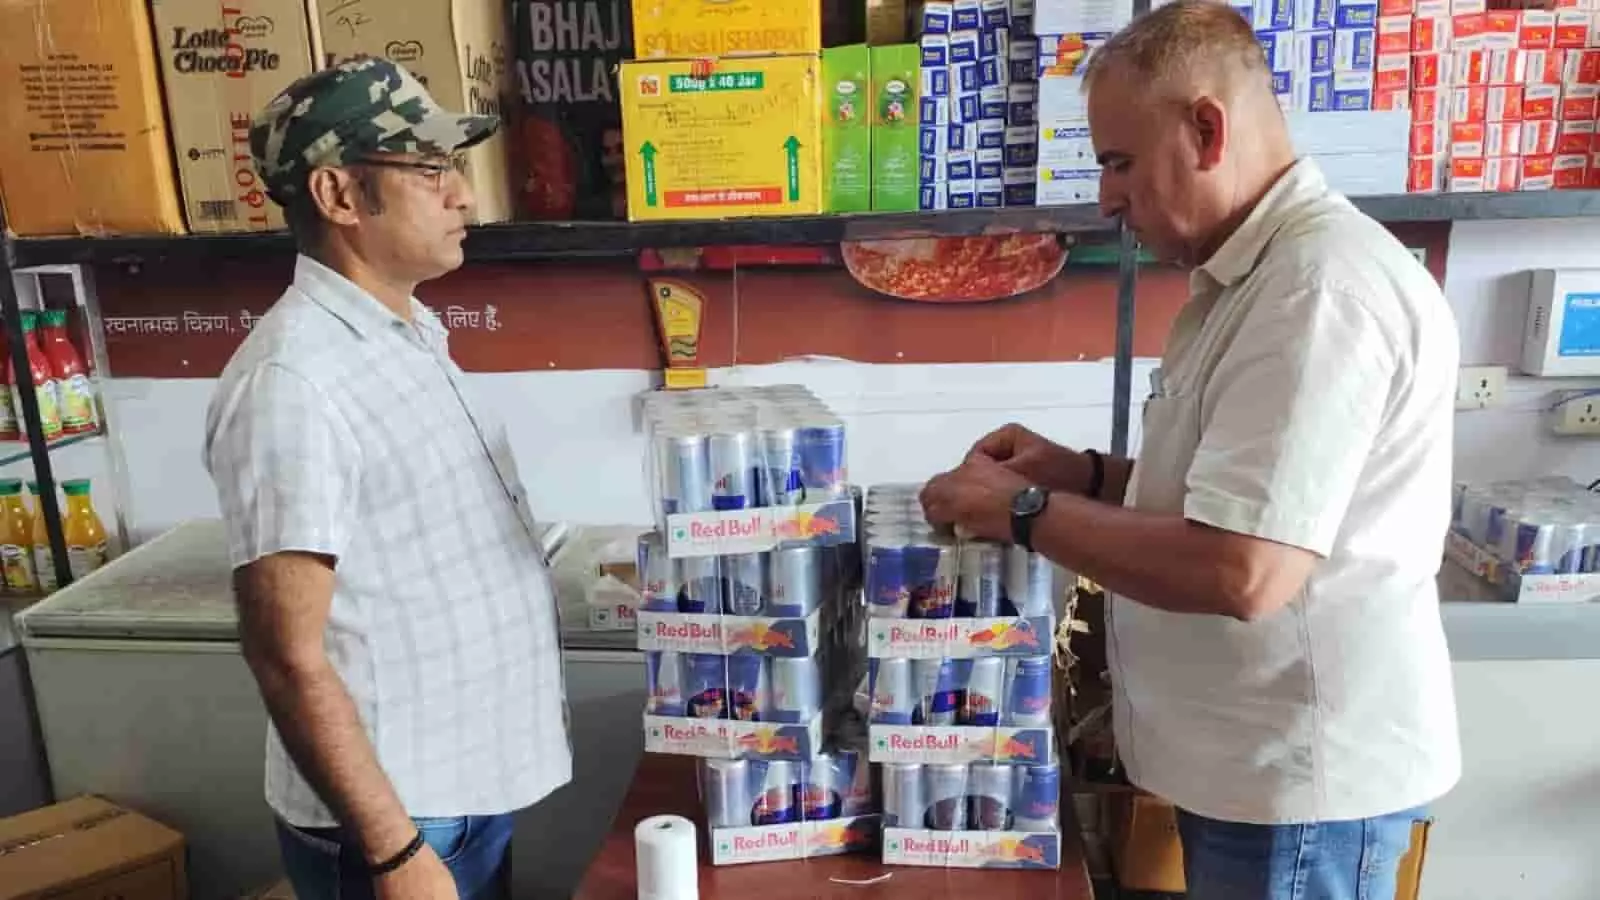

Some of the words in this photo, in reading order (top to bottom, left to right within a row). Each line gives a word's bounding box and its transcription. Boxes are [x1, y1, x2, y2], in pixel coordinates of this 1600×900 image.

[173, 27, 230, 48] Lotte
[173, 51, 241, 74] Choco
[245, 48, 280, 71] Pie
[737, 74, 757, 87] Jar
[446, 304, 480, 328] लिए
[104, 316, 179, 333] रचनात्मक
[690, 521, 726, 537] Red
[728, 517, 761, 536] Bull
[656, 622, 689, 638] Red
[690, 623, 721, 638] Bull
[891, 626, 925, 642] Red
[664, 724, 695, 739] Red
[890, 733, 924, 749] Red
[925, 734, 959, 749] Bull
[733, 836, 765, 850] Red
[767, 831, 799, 846] Bull
[903, 838, 936, 853] Red
[936, 838, 969, 853] Bull
